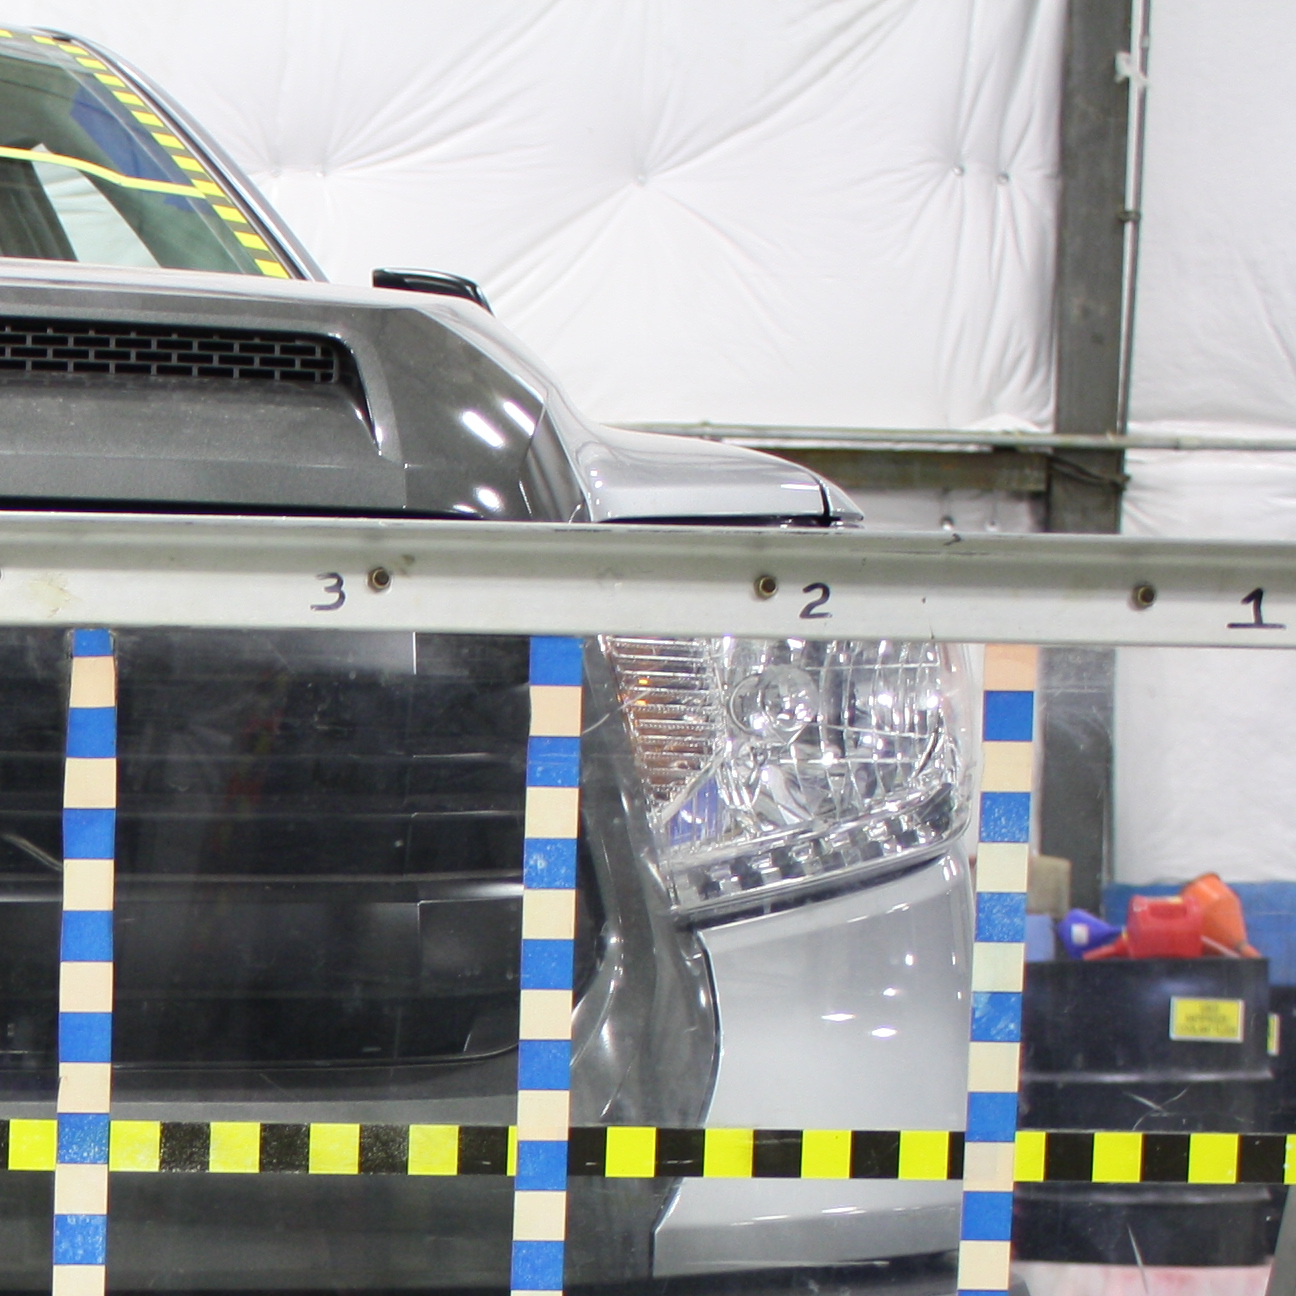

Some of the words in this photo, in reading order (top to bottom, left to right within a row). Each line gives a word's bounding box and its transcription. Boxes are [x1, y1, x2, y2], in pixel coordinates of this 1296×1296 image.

[312, 571, 346, 612] 3
[799, 583, 833, 620] 2
[1227, 587, 1285, 629] 1
